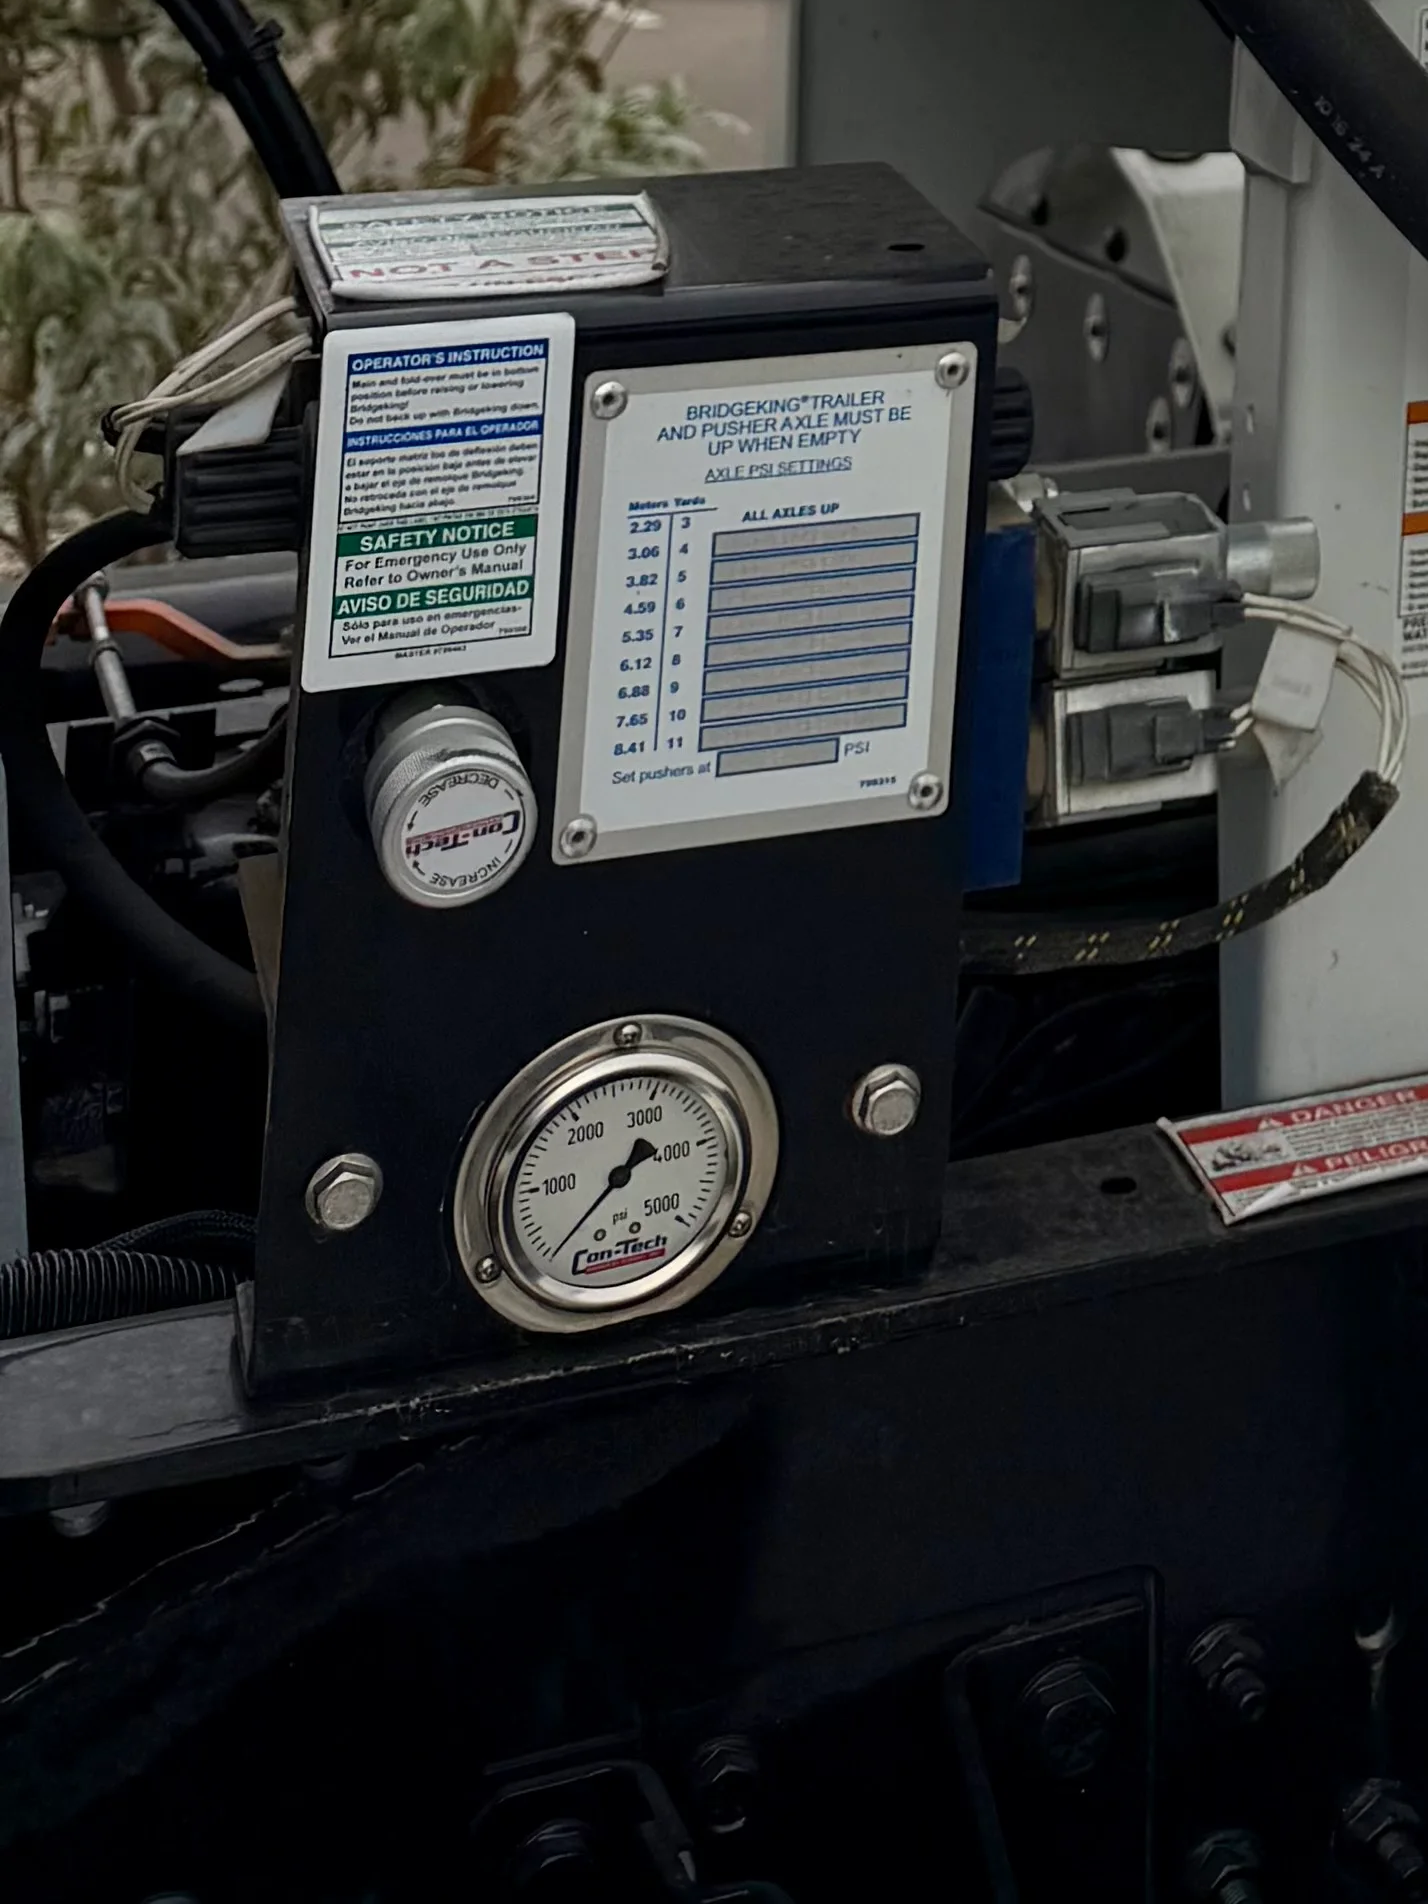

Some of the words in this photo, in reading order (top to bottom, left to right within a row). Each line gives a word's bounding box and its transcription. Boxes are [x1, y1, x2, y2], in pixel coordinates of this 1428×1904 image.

[352, 262, 459, 278] NOT
[480, 259, 513, 270] A
[352, 352, 444, 371] OPERATOR'S
[448, 344, 544, 362] INSTRUCTION
[351, 391, 392, 402] position
[395, 387, 428, 397] before
[481, 379, 524, 391] lowering
[811, 391, 885, 410] TRAILER
[347, 427, 432, 448] INSTRUCCIONES
[434, 426, 462, 439] PARA
[465, 424, 478, 436] EL
[481, 420, 539, 435] OPERADOR
[657, 426, 697, 441] AND
[701, 418, 777, 438] PUSHER
[780, 413, 828, 432] AXLE
[833, 409, 882, 427] MUST
[888, 406, 912, 421] BE
[708, 442, 733, 456] UP
[738, 436, 793, 452] WHEN
[798, 429, 862, 448] EMPTY
[705, 466, 743, 482] AXLE
[749, 464, 773, 478] PSI
[775, 456, 852, 476] SETTINGS
[742, 509, 768, 522] ALL
[772, 505, 816, 520] AXLES
[820, 503, 839, 515] UP
[630, 520, 661, 533] 2.29
[681, 517, 691, 528] 3
[360, 529, 437, 552] SAFETY
[442, 522, 514, 541] NOTICE
[345, 559, 371, 572] For
[375, 551, 456, 569] Emergency
[462, 546, 489, 559] Use
[493, 543, 526, 558] Only
[628, 546, 660, 559] 3.06
[680, 544, 688, 554] 4
[345, 574, 384, 589] Refer
[388, 572, 402, 584] to
[407, 566, 466, 582] Owner's
[472, 560, 523, 575] Manual
[626, 574, 658, 587] 3.82
[678, 571, 687, 582] 5
[337, 594, 391, 616] AVISO
[397, 592, 421, 607] DE
[426, 580, 529, 605] SEGURIDAD
[624, 601, 656, 614] 4.59
[676, 599, 685, 609] 6
[342, 634, 361, 645] Ver
[364, 633, 375, 643] el
[378, 628, 421, 641] Manual
[423, 626, 437, 636] de
[441, 621, 495, 635] Operador
[373, 617, 399, 630] para
[402, 616, 423, 624] uso
[426, 613, 440, 622] en
[622, 629, 654, 643] 5.35
[674, 626, 683, 638] 7
[620, 657, 652, 671] 6.12
[672, 654, 681, 666] 8
[618, 685, 650, 699] 6.88
[670, 682, 679, 693] 9
[617, 713, 648, 728] 7.65
[669, 710, 686, 721] 10
[614, 742, 645, 756] 8.41
[667, 738, 683, 749] 11
[844, 742, 869, 756] PSI
[612, 771, 635, 784] Set
[639, 764, 694, 784] pushers
[698, 762, 711, 774] at
[418, 772, 499, 807] DECREASE
[405, 810, 521, 857] Con-Tech
[429, 856, 501, 887] INCREASE
[627, 1105, 662, 1128] 3000
[1291, 1090, 1416, 1123] DANGER
[568, 1122, 604, 1145] 2000
[653, 1141, 690, 1163] 4000
[542, 1173, 576, 1196] 1000
[644, 1193, 679, 1216] 5000
[613, 1208, 628, 1225] psi
[572, 1234, 667, 1275] Con-Tech
